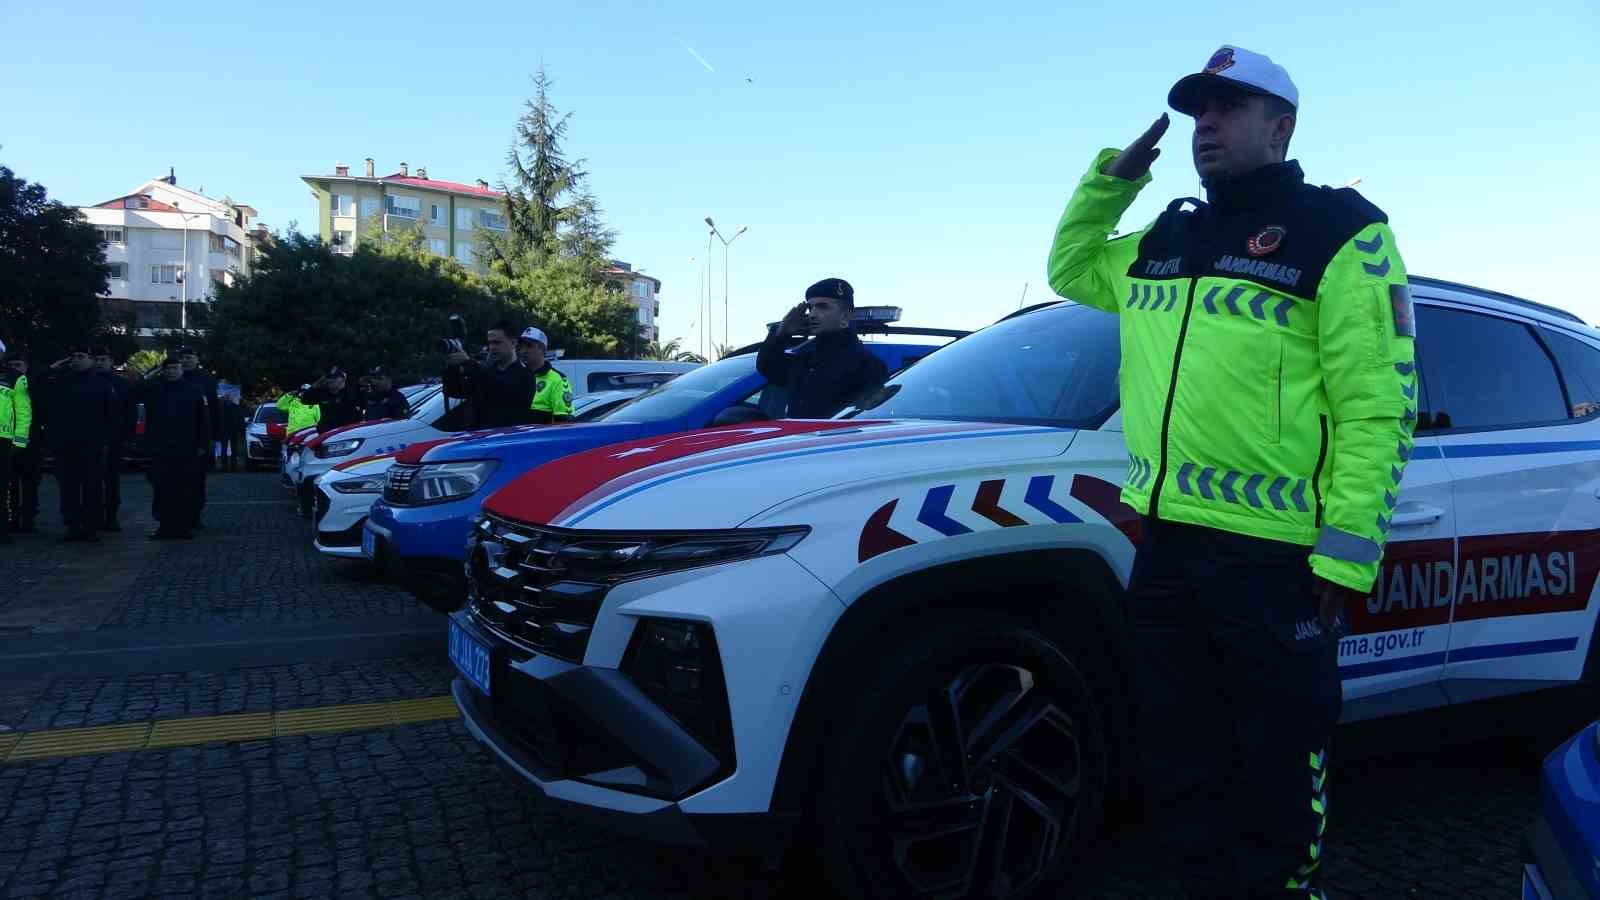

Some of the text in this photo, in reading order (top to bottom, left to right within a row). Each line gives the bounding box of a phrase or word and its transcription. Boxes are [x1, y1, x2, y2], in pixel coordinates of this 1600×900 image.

[1214, 255, 1302, 287] JANDARMASI
[1366, 551, 1576, 614] JANDARMASI
[1338, 629, 1425, 657] ma.gov.tr
